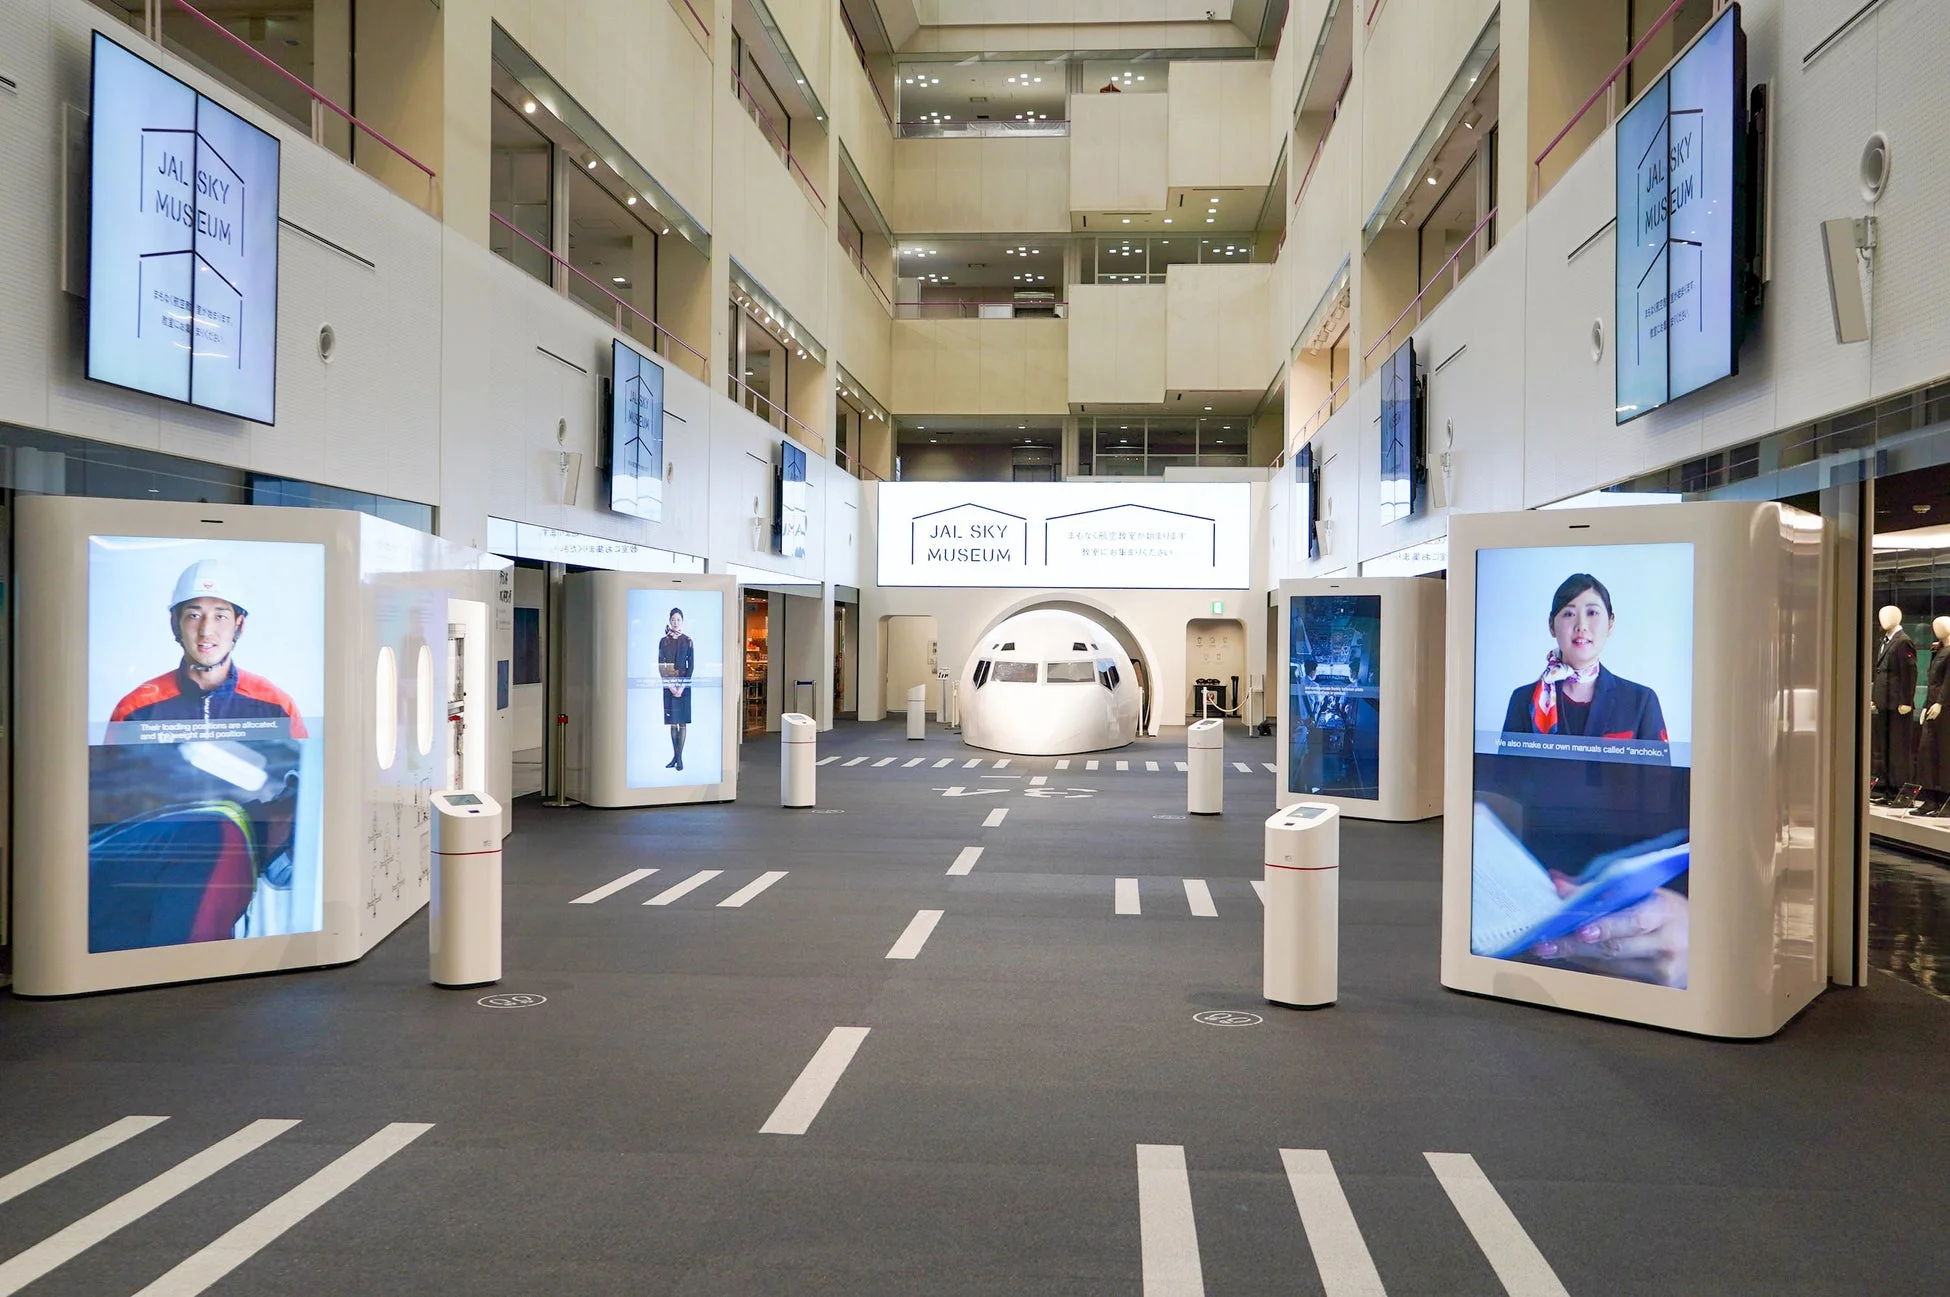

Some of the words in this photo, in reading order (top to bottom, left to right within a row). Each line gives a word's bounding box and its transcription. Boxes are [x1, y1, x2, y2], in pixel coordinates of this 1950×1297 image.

[1646, 159, 1665, 193] JAL
[1669, 131, 1692, 173] SKY
[158, 151, 189, 187] JAL
[197, 170, 229, 205] SKY
[1645, 174, 1694, 235] MUSEUM
[156, 189, 231, 246] MUSEUM
[929, 524, 963, 539] JAL
[970, 524, 1008, 539] SKY
[927, 548, 1011, 562] MUSEUM
[162, 723, 191, 732] loading
[192, 722, 228, 732] positions
[242, 721, 278, 729] allocated,
[140, 732, 157, 740] and
[216, 730, 246, 738] position
[1507, 739, 1522, 748] also
[1522, 740, 1541, 749] make
[1542, 742, 1554, 750] our
[1555, 743, 1571, 751] own
[1571, 744, 1601, 753] manuals
[1602, 745, 1625, 754] called
